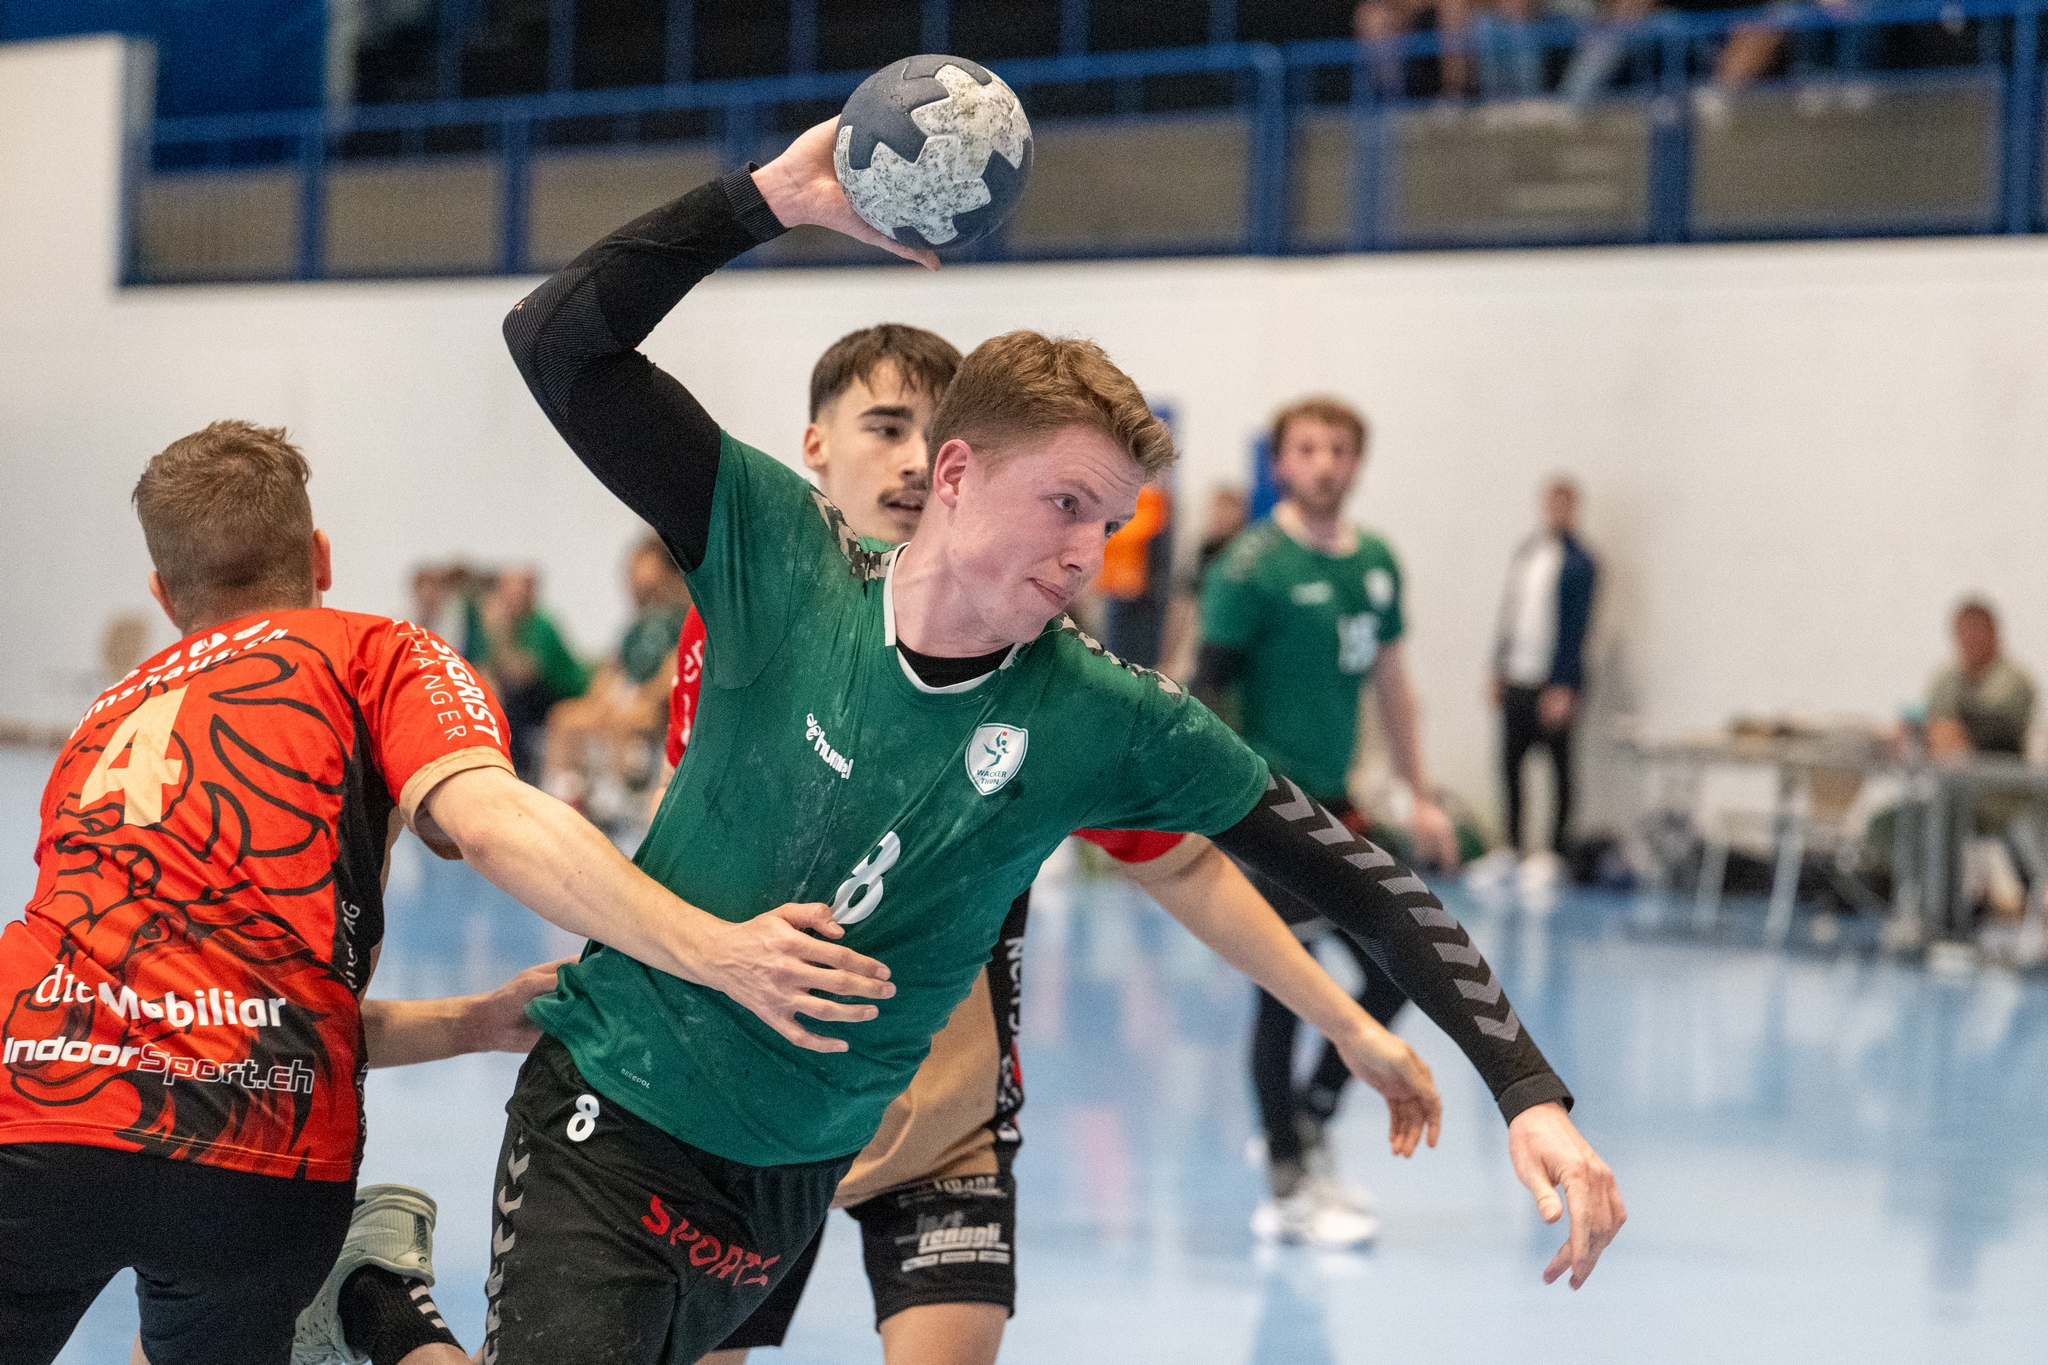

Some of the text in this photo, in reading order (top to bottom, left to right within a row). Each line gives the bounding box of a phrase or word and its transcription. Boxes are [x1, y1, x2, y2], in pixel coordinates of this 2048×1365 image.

[79, 684, 190, 826] 4
[977, 769, 1007, 778] WACKER
[980, 777, 999, 785] THUN
[828, 831, 900, 925] 8
[98, 982, 287, 1027] Mobiliar
[2, 1036, 315, 1094] IndoorSport.ch
[566, 1094, 600, 1142] 8
